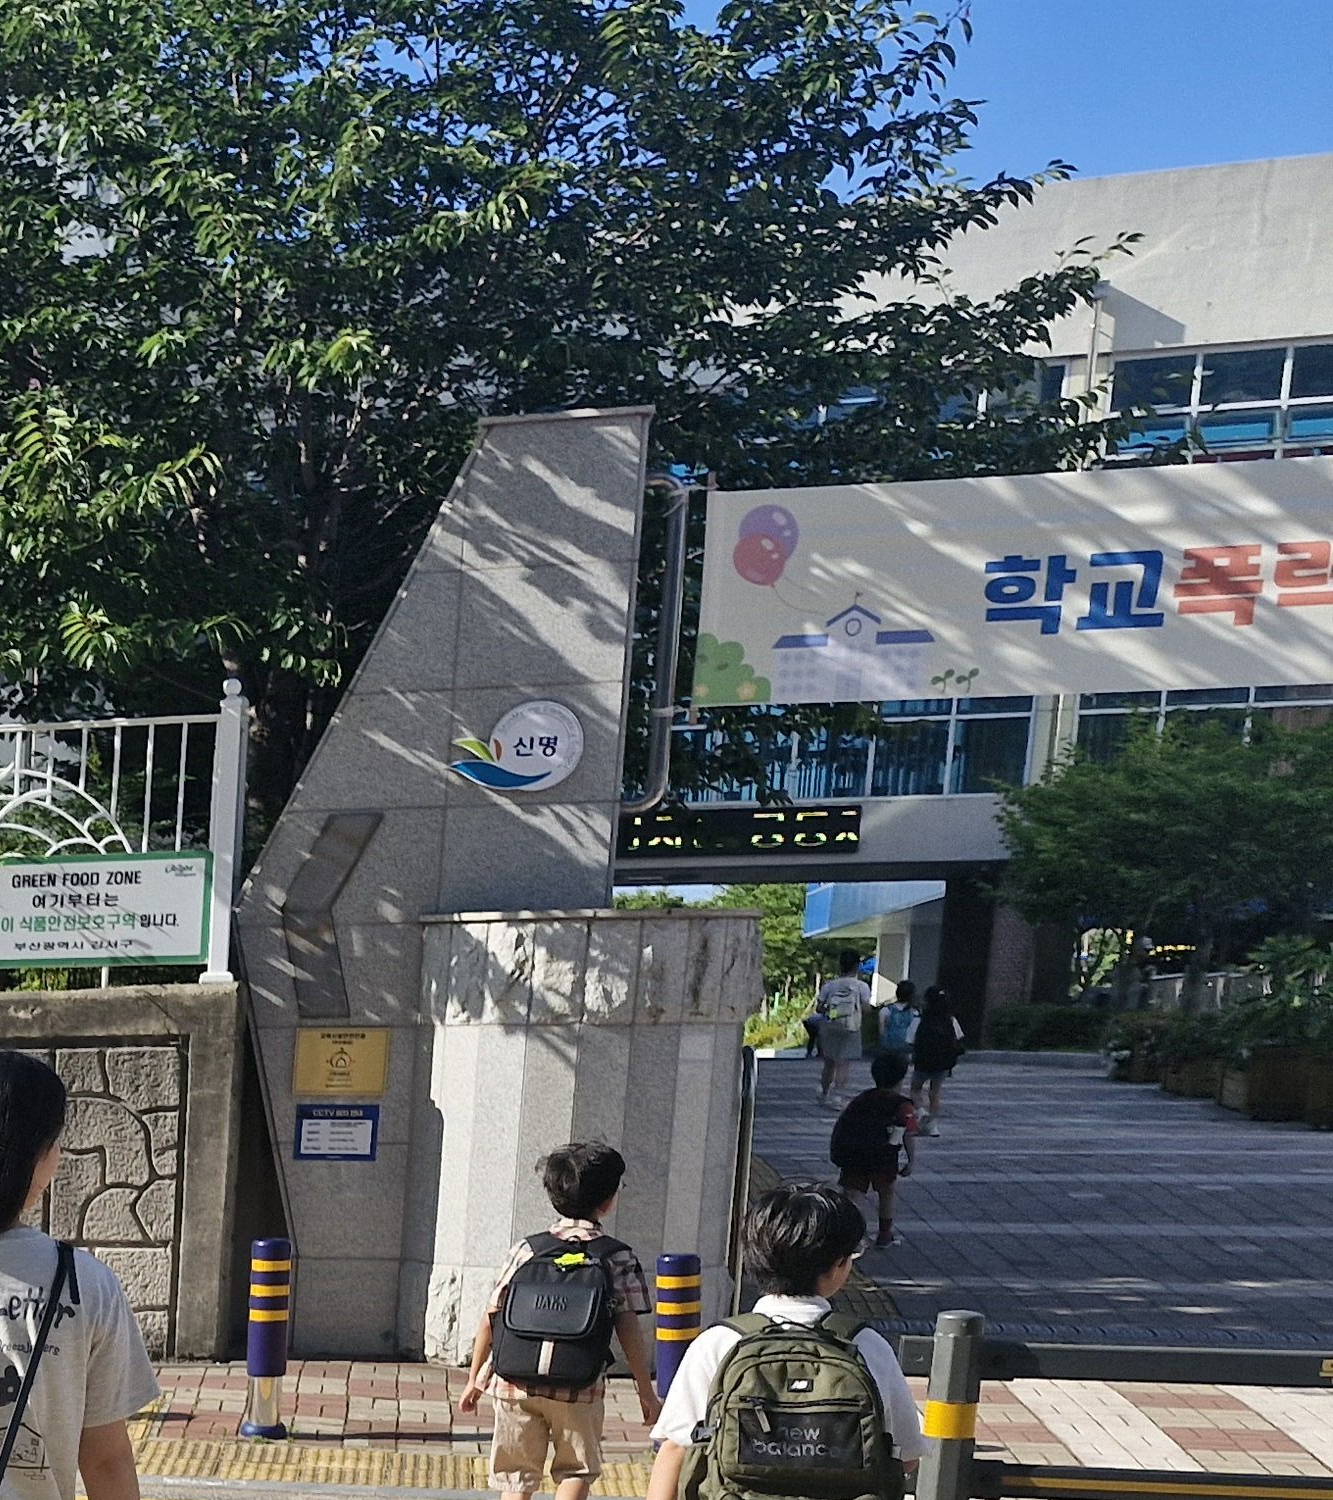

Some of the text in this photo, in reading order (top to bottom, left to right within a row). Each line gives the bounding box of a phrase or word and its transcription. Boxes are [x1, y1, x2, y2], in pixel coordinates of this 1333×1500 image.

[513, 735, 558, 757] 신명
[12, 870, 142, 888] GREEN FOOD ZONE
[32, 893, 119, 908] 여기부터는
[14, 940, 84, 951] 부산광역시
